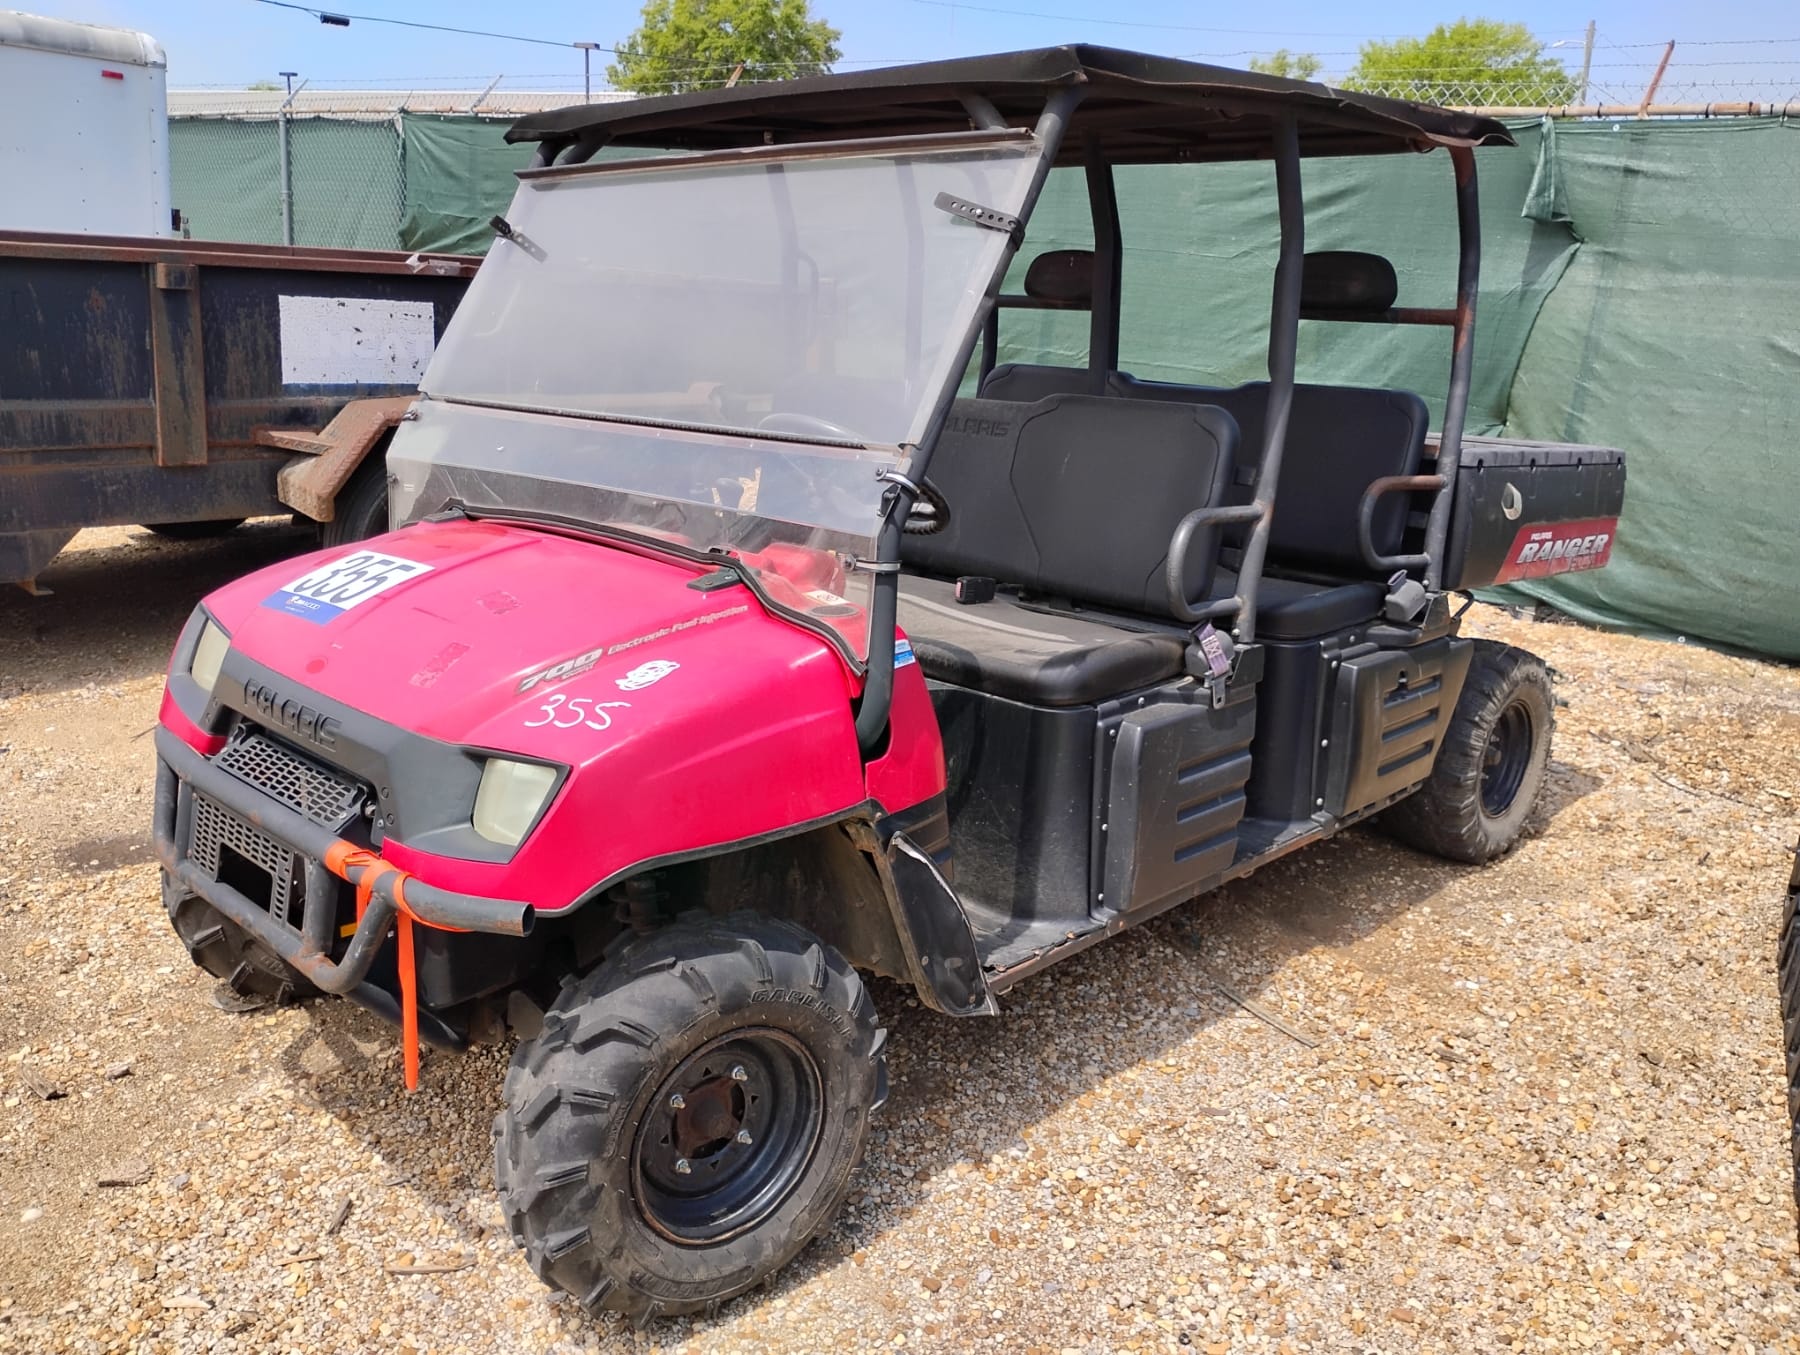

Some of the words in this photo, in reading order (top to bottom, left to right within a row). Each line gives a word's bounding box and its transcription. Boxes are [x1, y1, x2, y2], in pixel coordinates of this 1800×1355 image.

[1516, 534, 1609, 563] RANGER
[293, 555, 416, 604] 355
[517, 648, 603, 693] 700
[607, 627, 671, 655] Electronic
[671, 617, 699, 633] Fuel
[699, 605, 749, 624] Injection
[243, 677, 343, 753] POLARIS
[523, 693, 633, 731] 355
